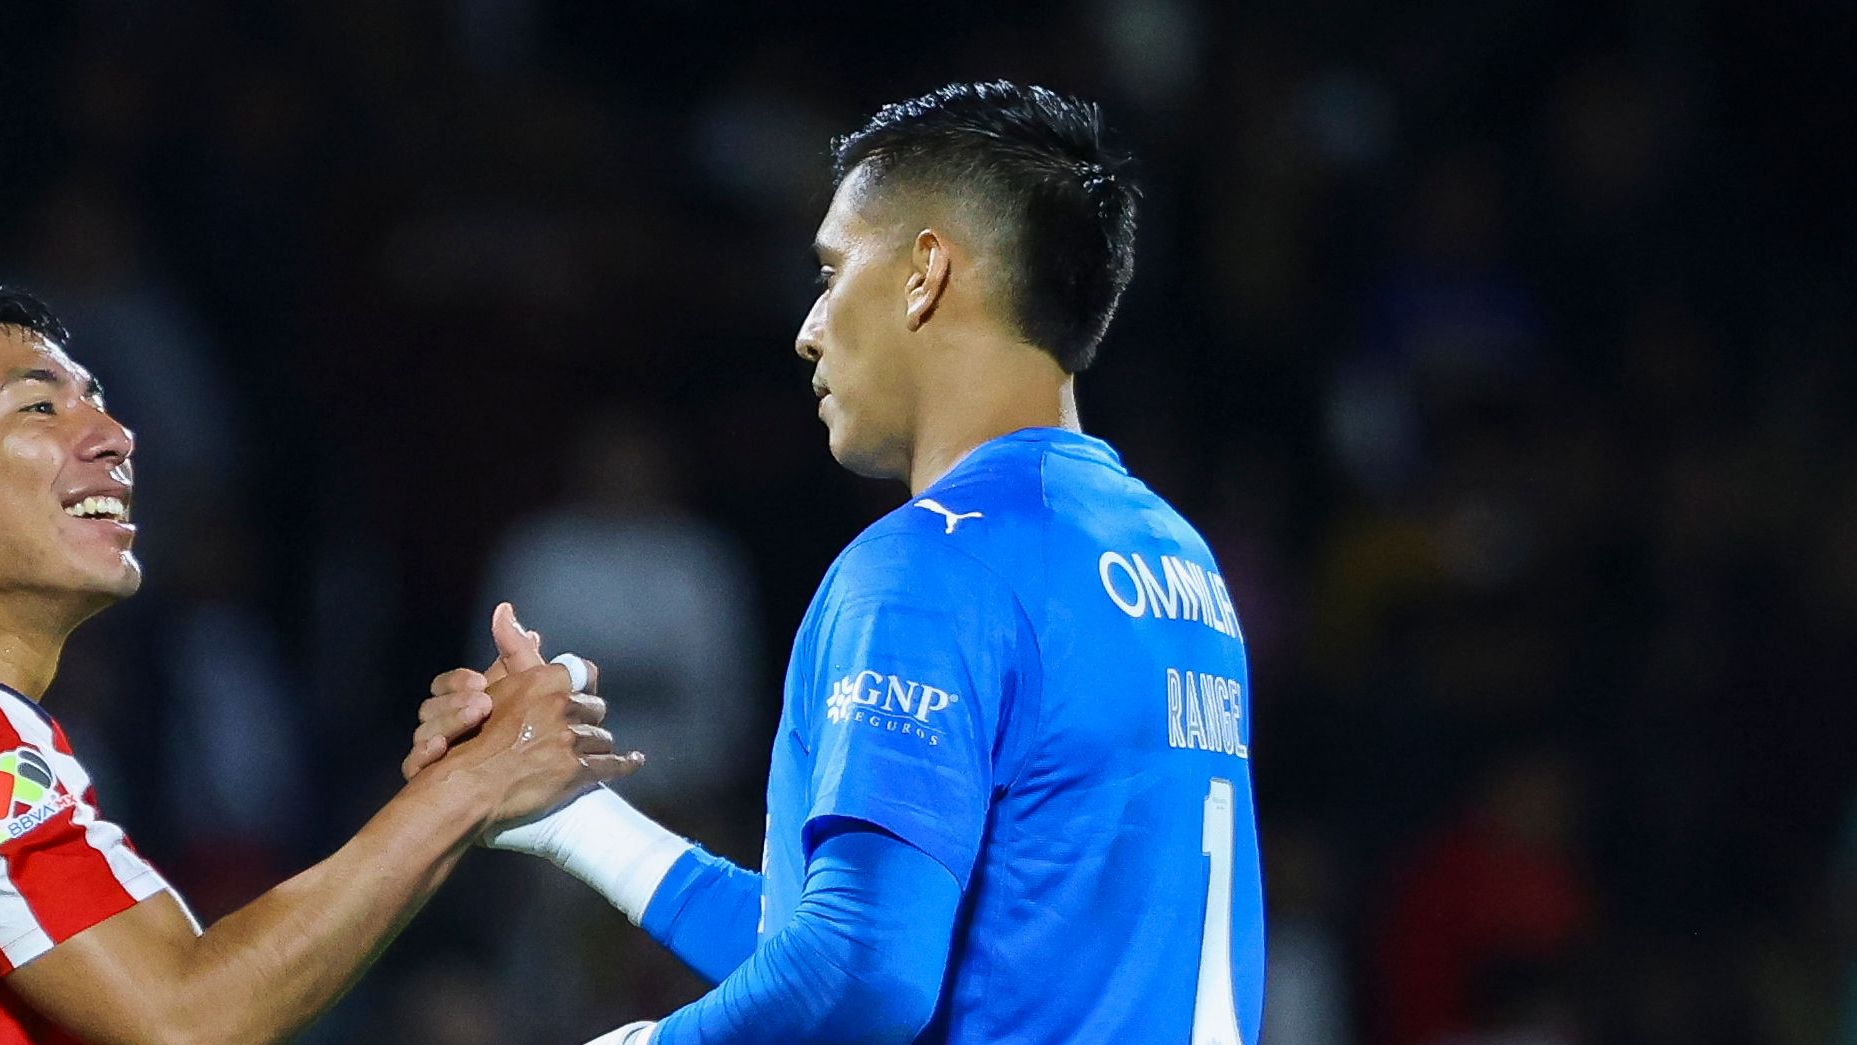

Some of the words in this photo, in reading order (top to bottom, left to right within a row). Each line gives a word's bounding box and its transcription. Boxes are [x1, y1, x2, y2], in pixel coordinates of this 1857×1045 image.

[1099, 551, 1240, 640] OMNILIF
[851, 670, 950, 723] GNP
[850, 710, 939, 746] EGUROS
[7, 804, 56, 837] BBVA
